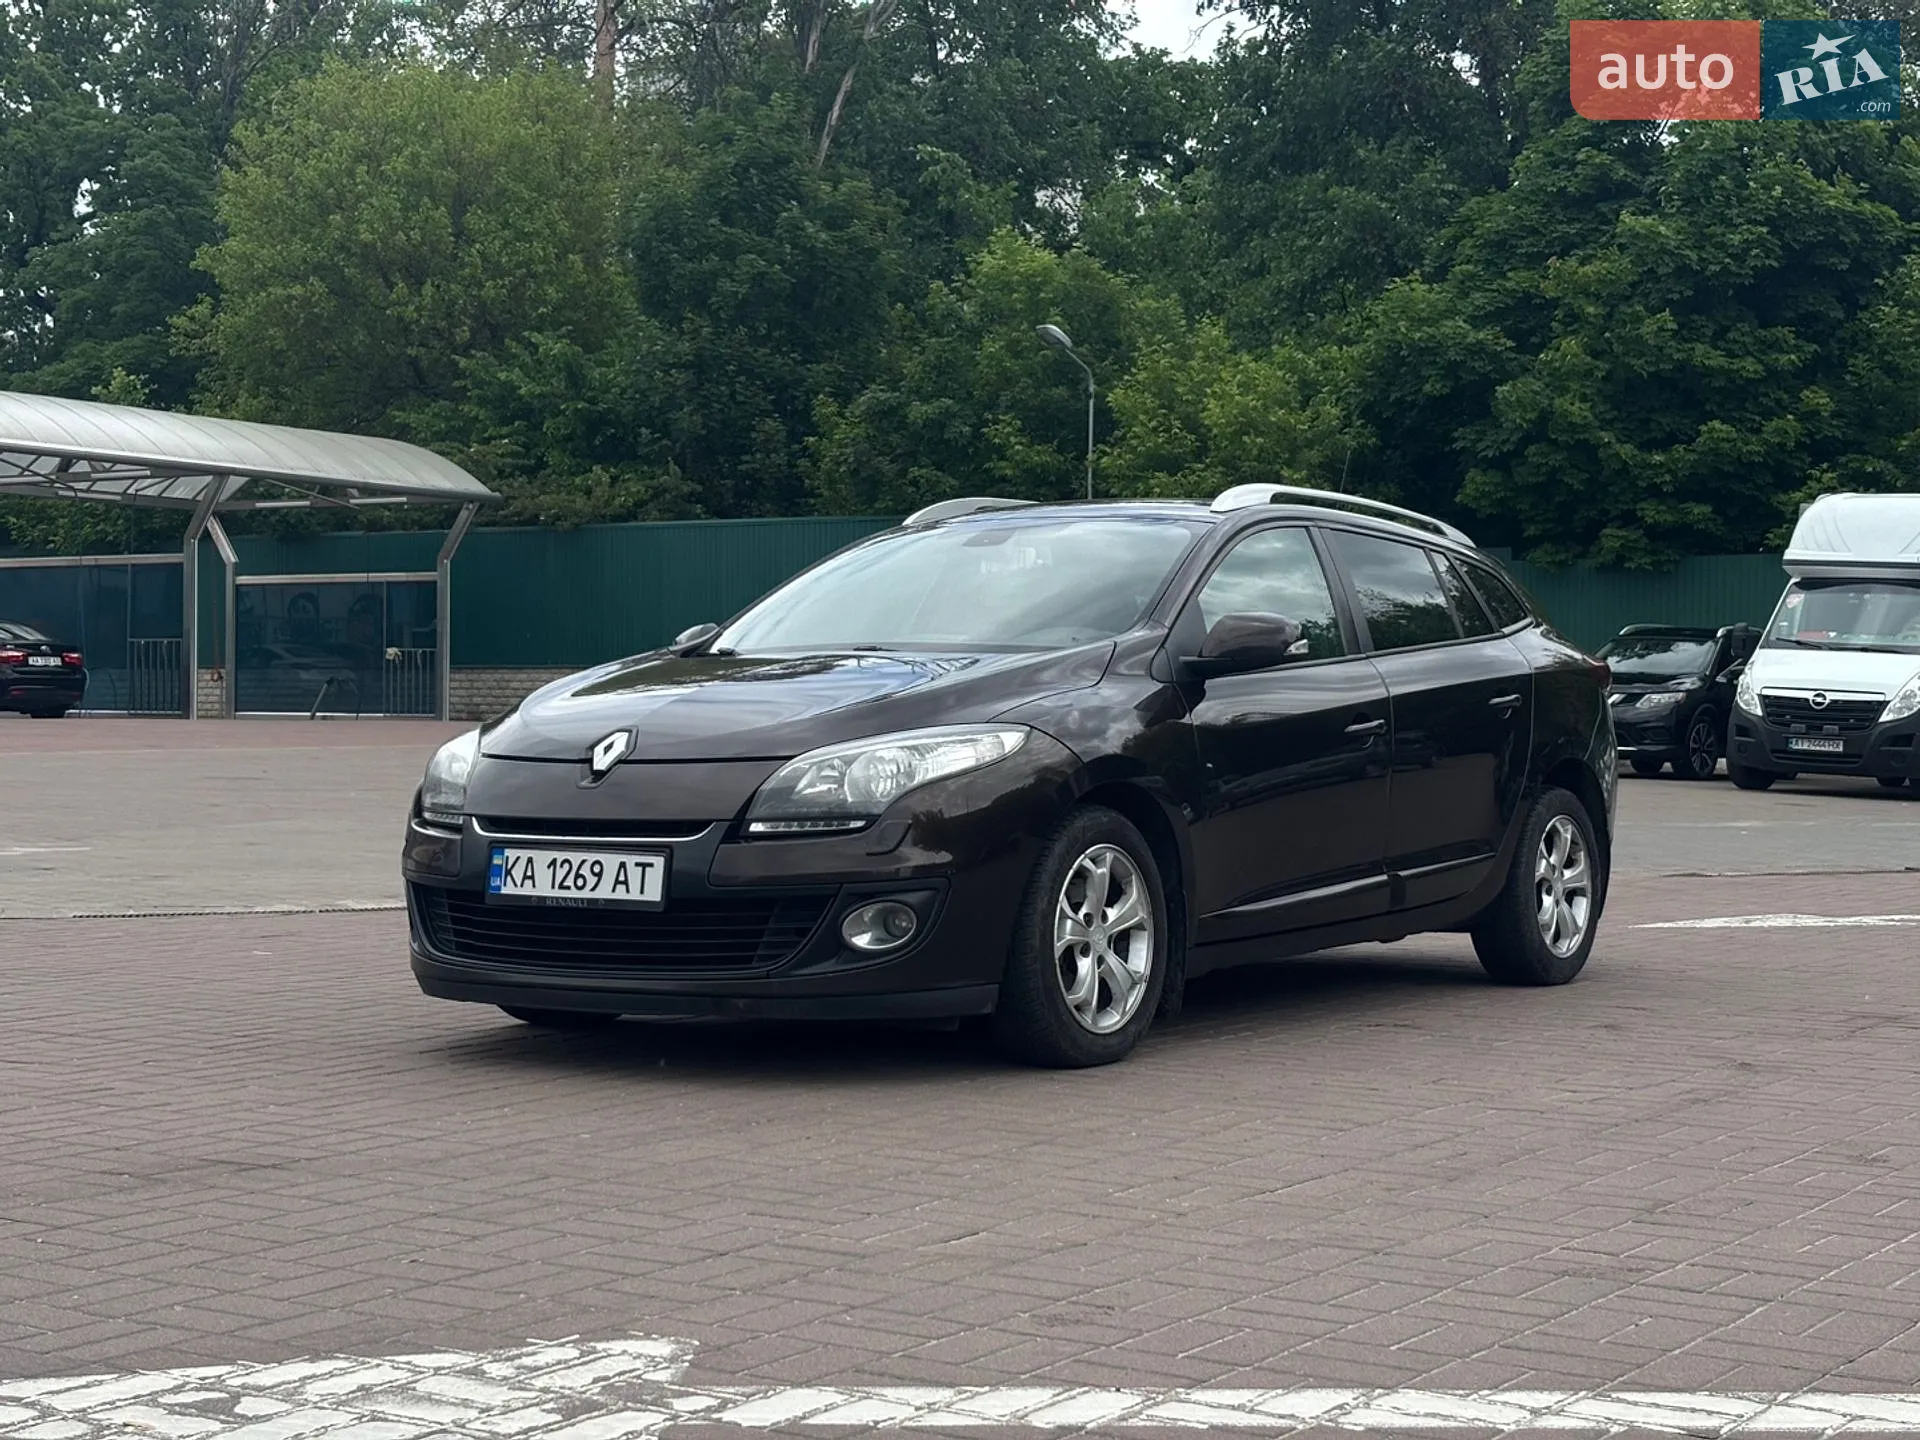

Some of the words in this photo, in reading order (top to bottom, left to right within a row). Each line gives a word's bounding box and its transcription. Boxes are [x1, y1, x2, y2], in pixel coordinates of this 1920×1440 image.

[504, 856, 536, 888] KA
[547, 857, 604, 892] 1269
[611, 861, 654, 895] AT
[546, 897, 588, 907] RENAULT
